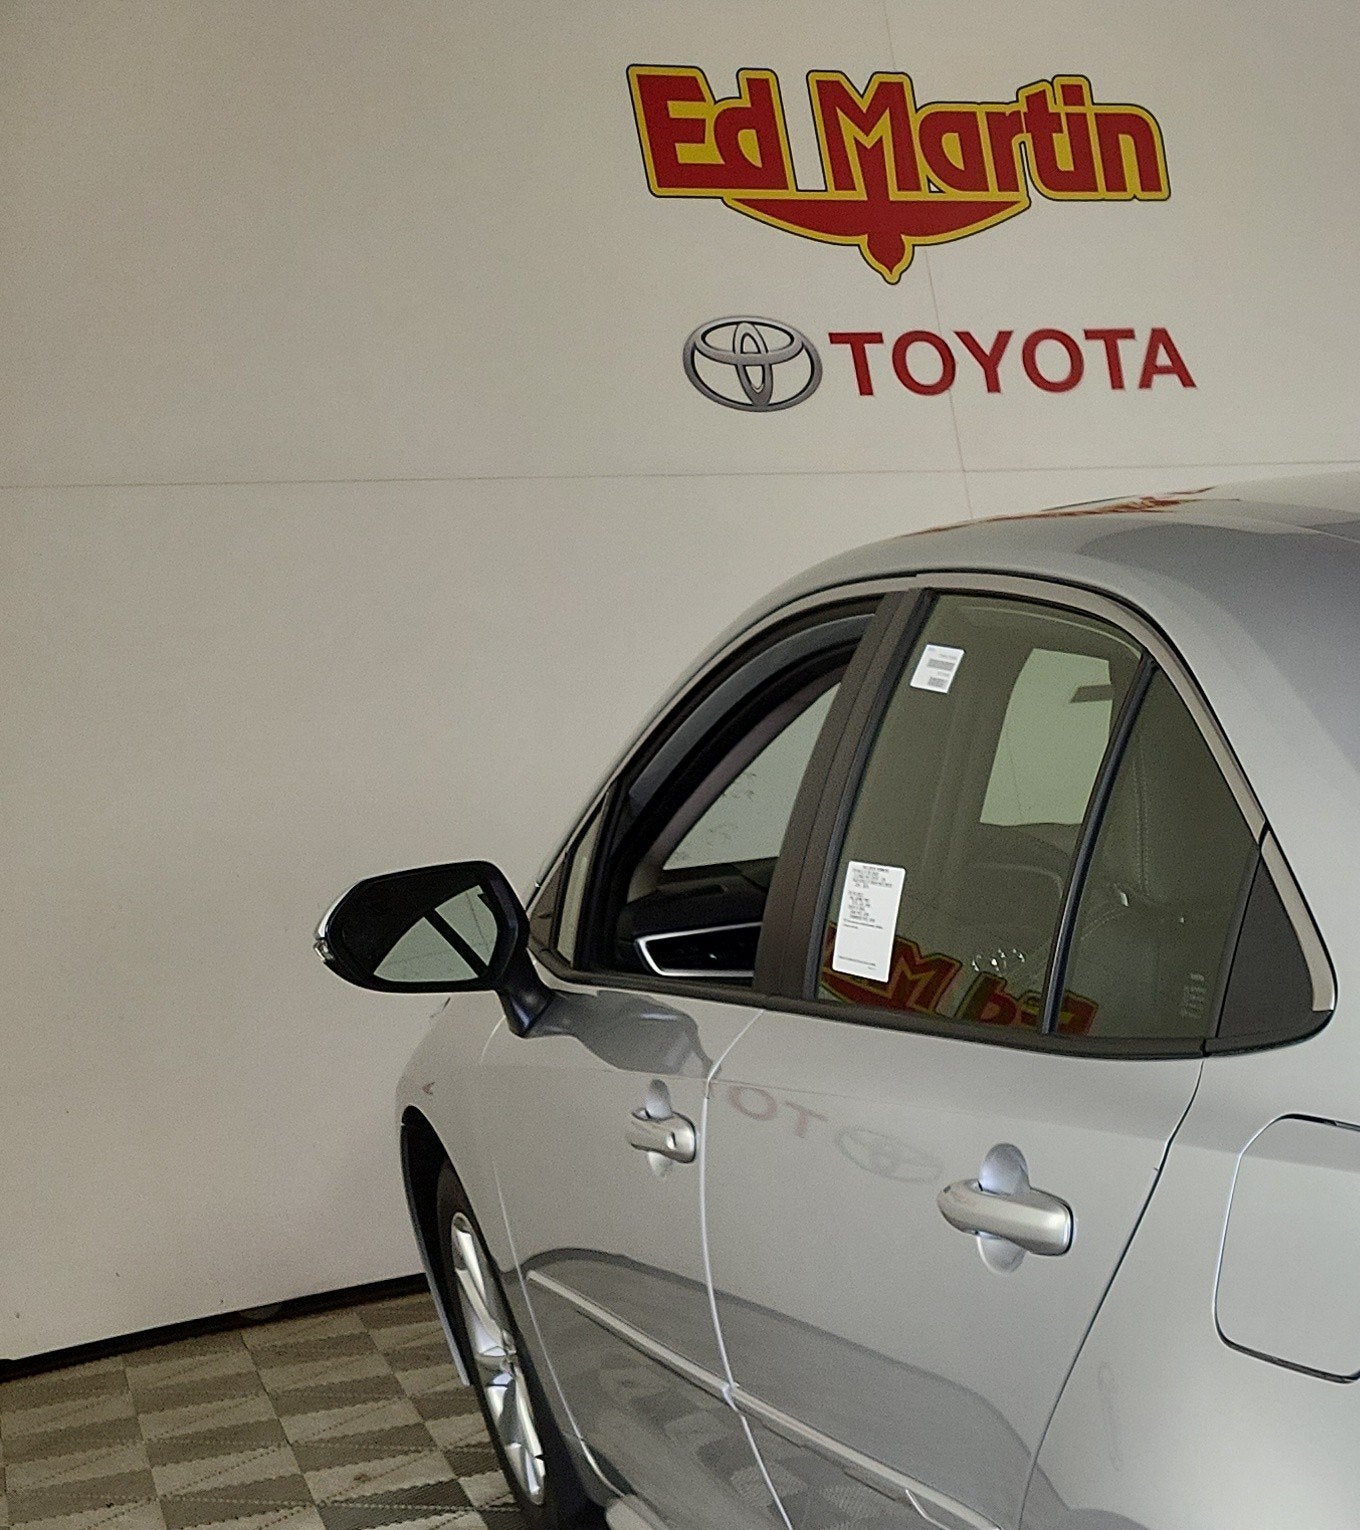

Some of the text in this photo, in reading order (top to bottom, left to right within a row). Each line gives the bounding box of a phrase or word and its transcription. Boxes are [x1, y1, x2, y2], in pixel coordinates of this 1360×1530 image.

[628, 65, 1170, 201] Ed Martin
[829, 327, 1197, 397] TOYOTA
